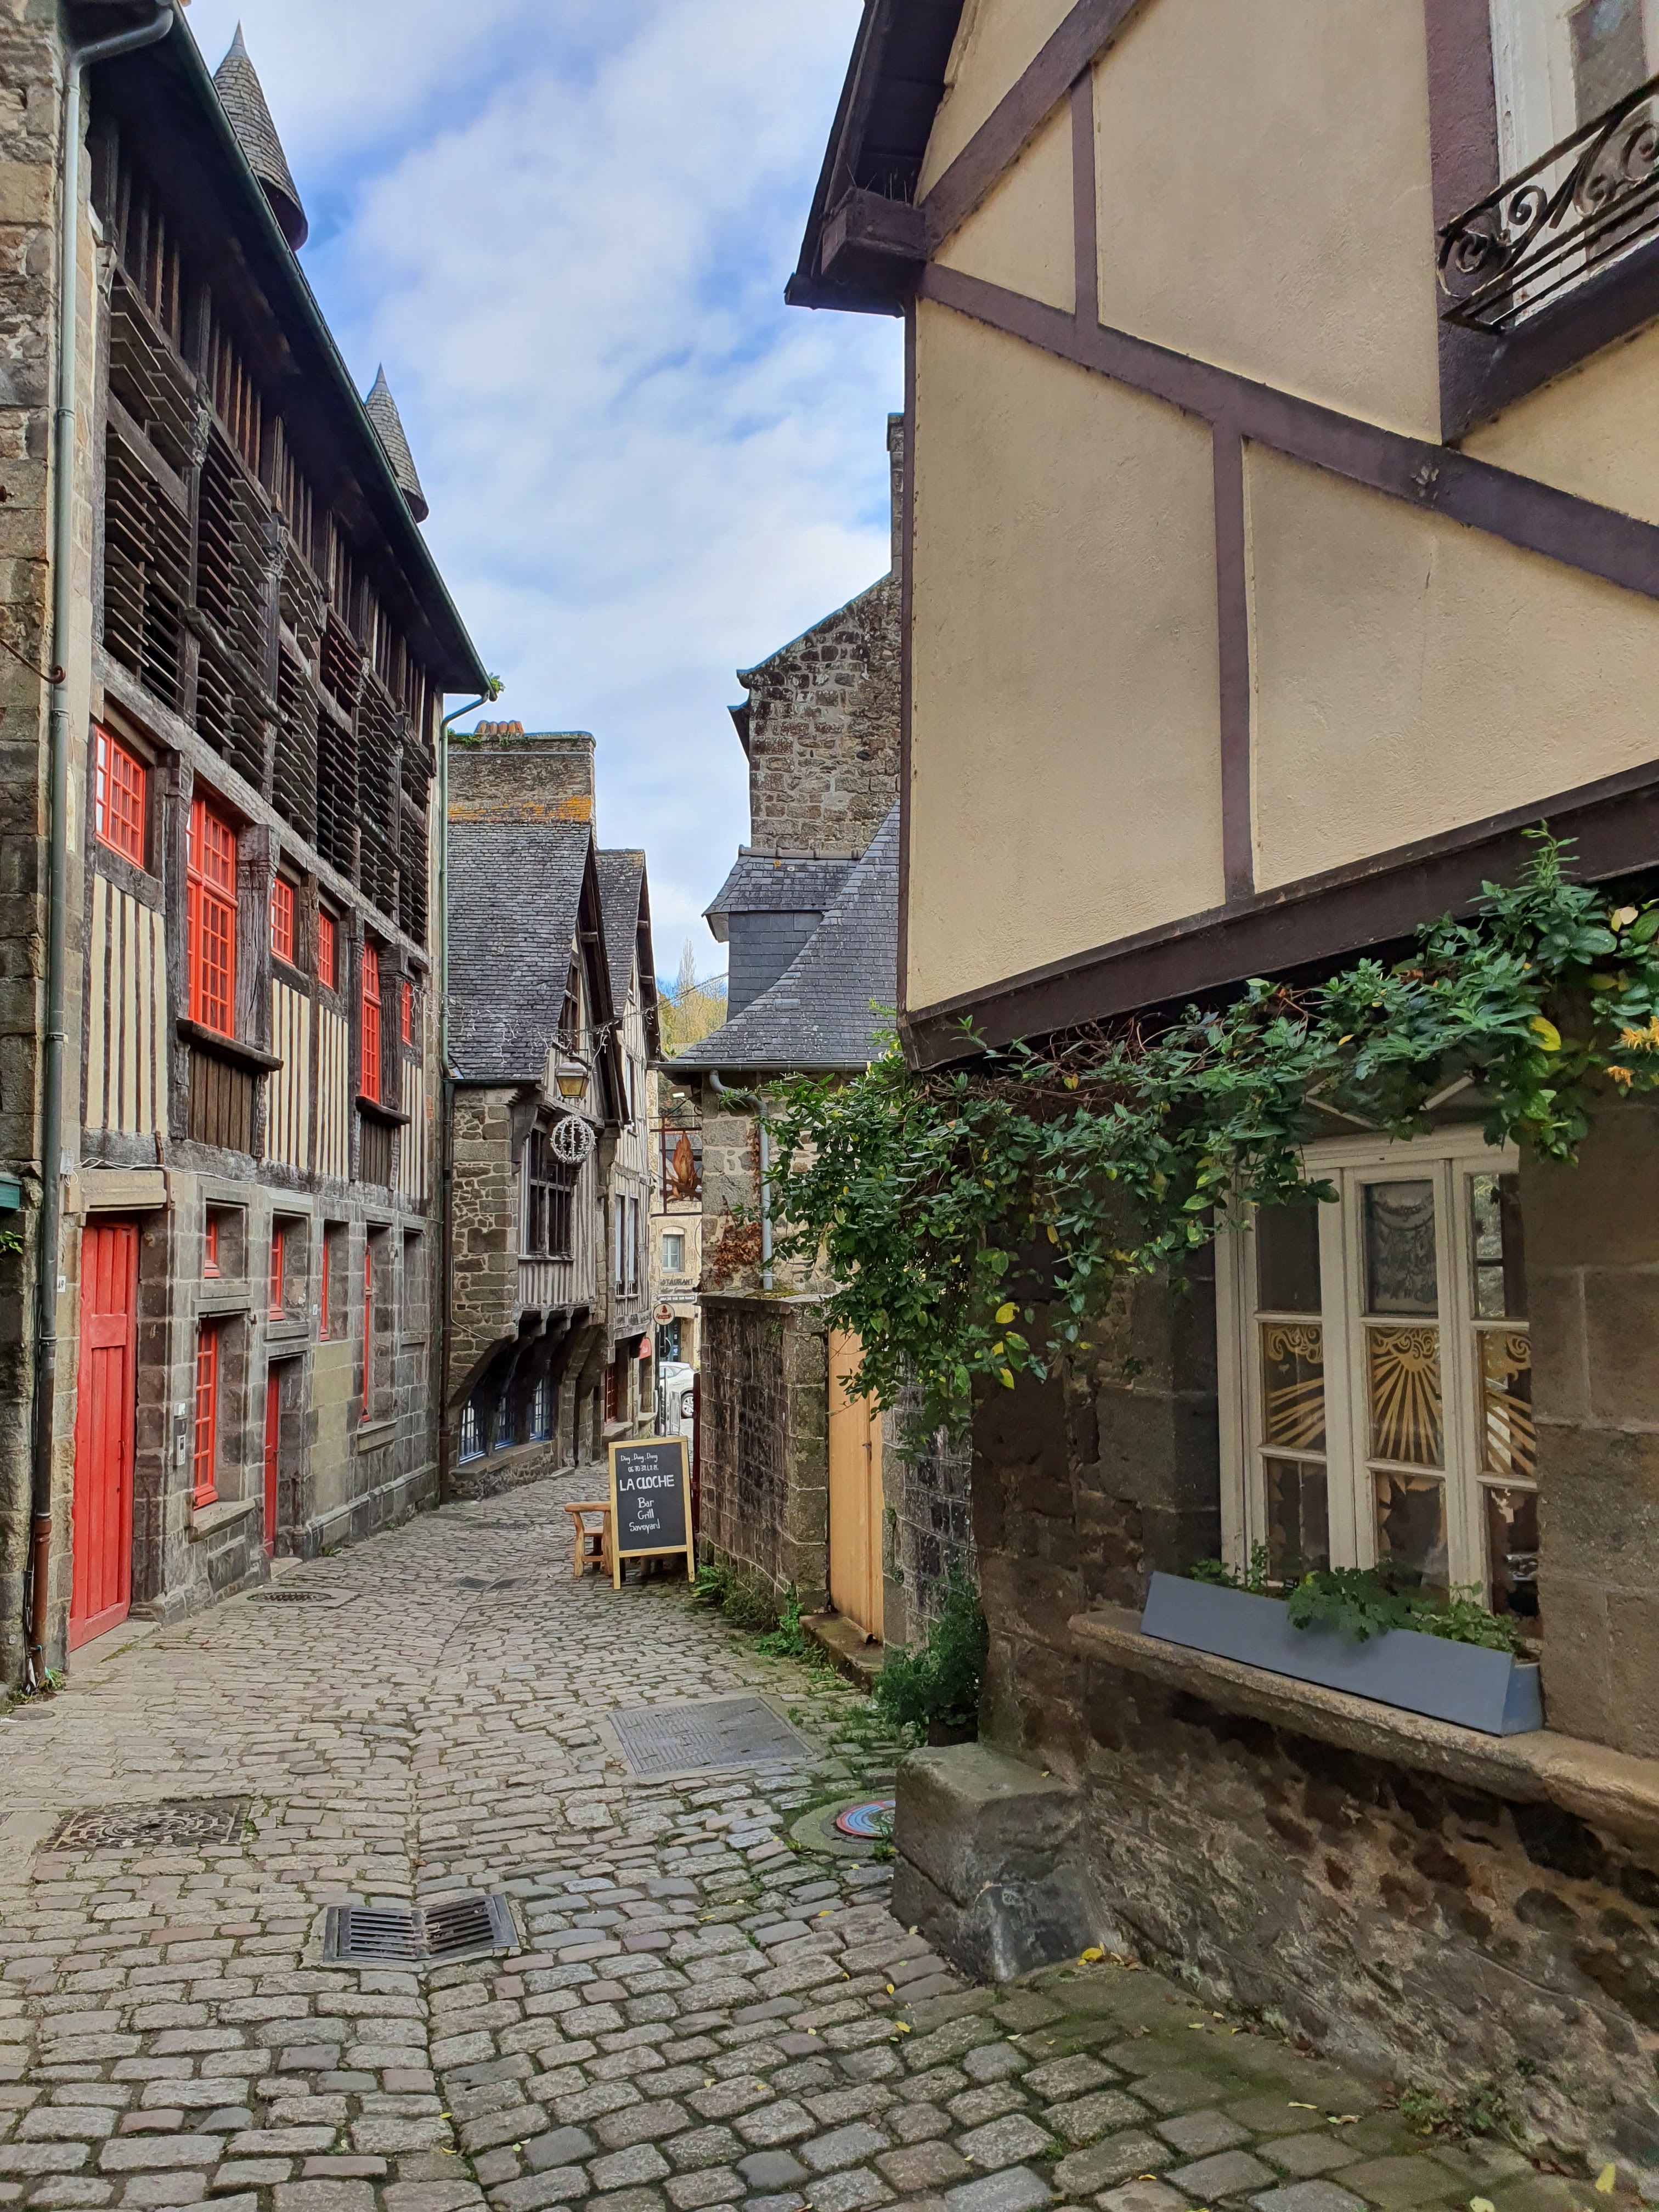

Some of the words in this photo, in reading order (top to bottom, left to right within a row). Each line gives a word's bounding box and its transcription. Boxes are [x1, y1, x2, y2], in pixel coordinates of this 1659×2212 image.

[619, 1479, 635, 1491] LA
[636, 1474, 675, 1489] CLOCHE
[637, 1497, 654, 1508] Bar
[637, 1508, 654, 1520] Grill
[629, 1518, 661, 1534] Savoyard
